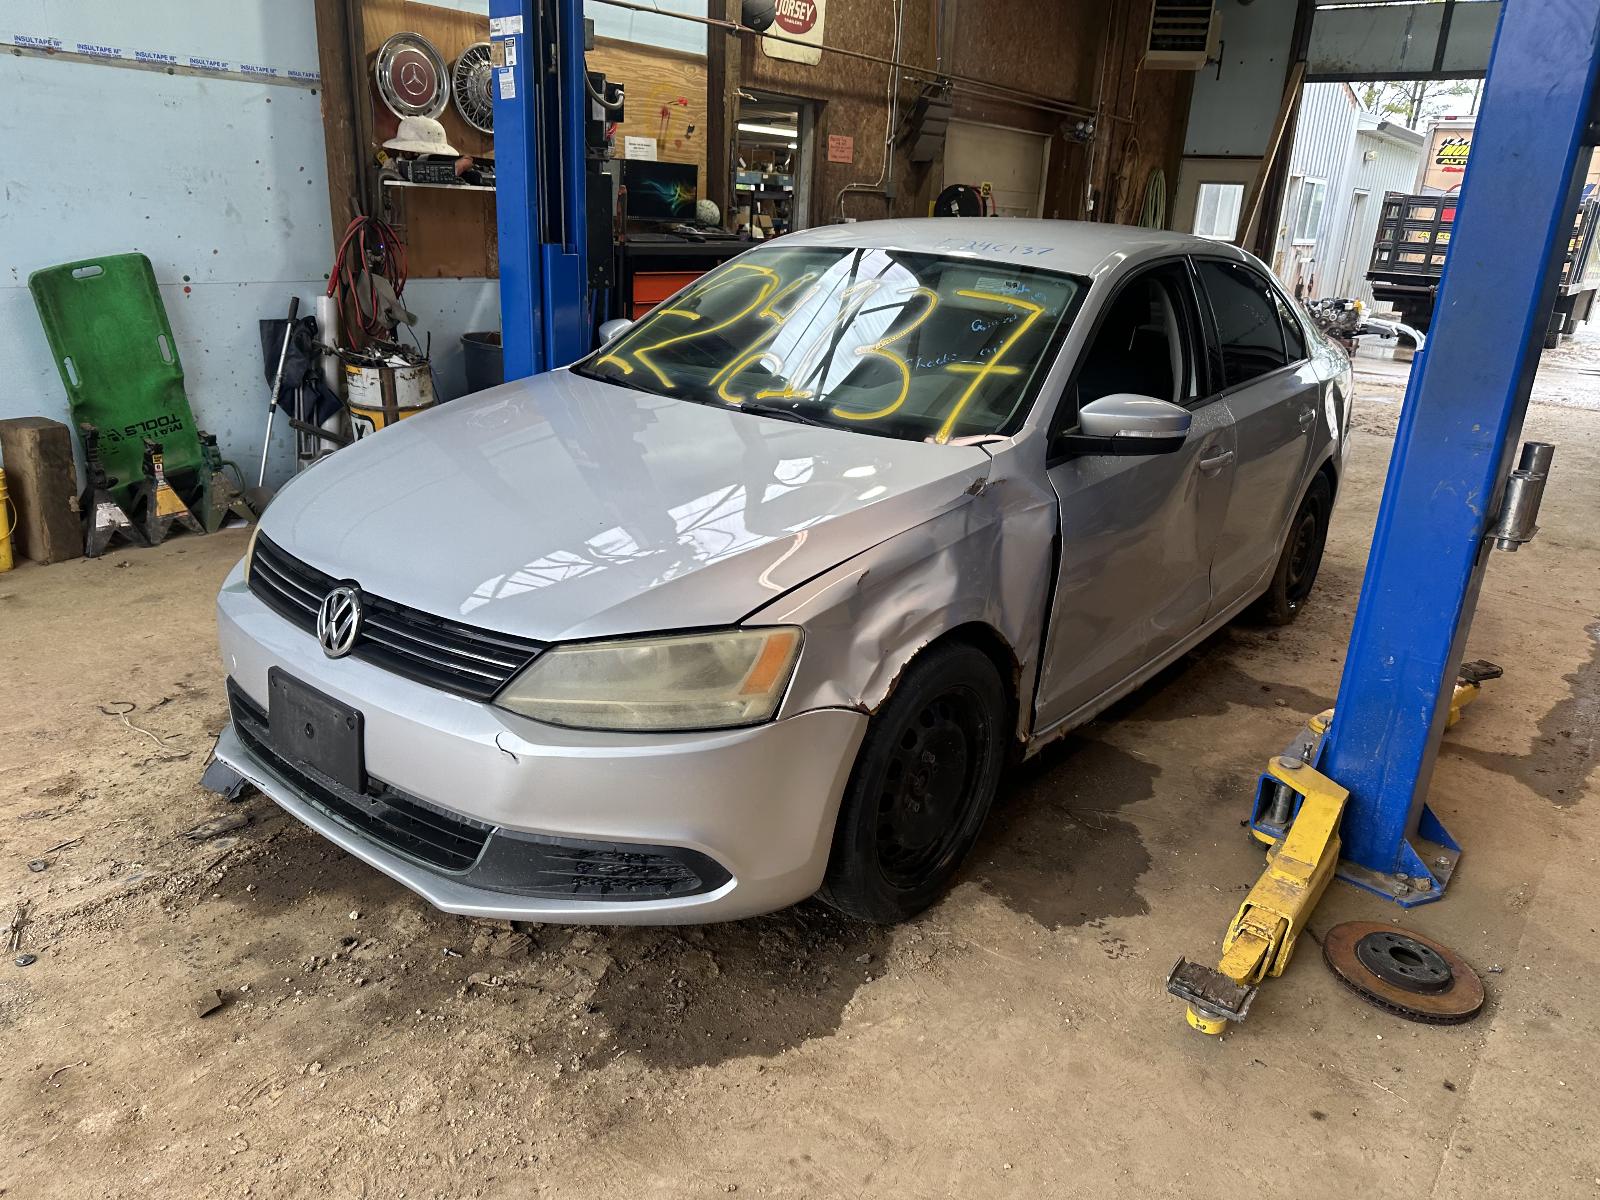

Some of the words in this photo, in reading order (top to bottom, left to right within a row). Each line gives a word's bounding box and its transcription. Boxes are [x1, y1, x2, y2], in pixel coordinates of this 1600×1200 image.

[13, 34, 52, 45] INSULTAPE
[77, 43, 112, 53] INSULTAPE
[135, 50, 168, 60] INSULTAPE
[189, 57, 220, 66] INSULTAPE
[240, 64, 269, 72] INSULTAPE
[125, 413, 181, 437] TOOLS
